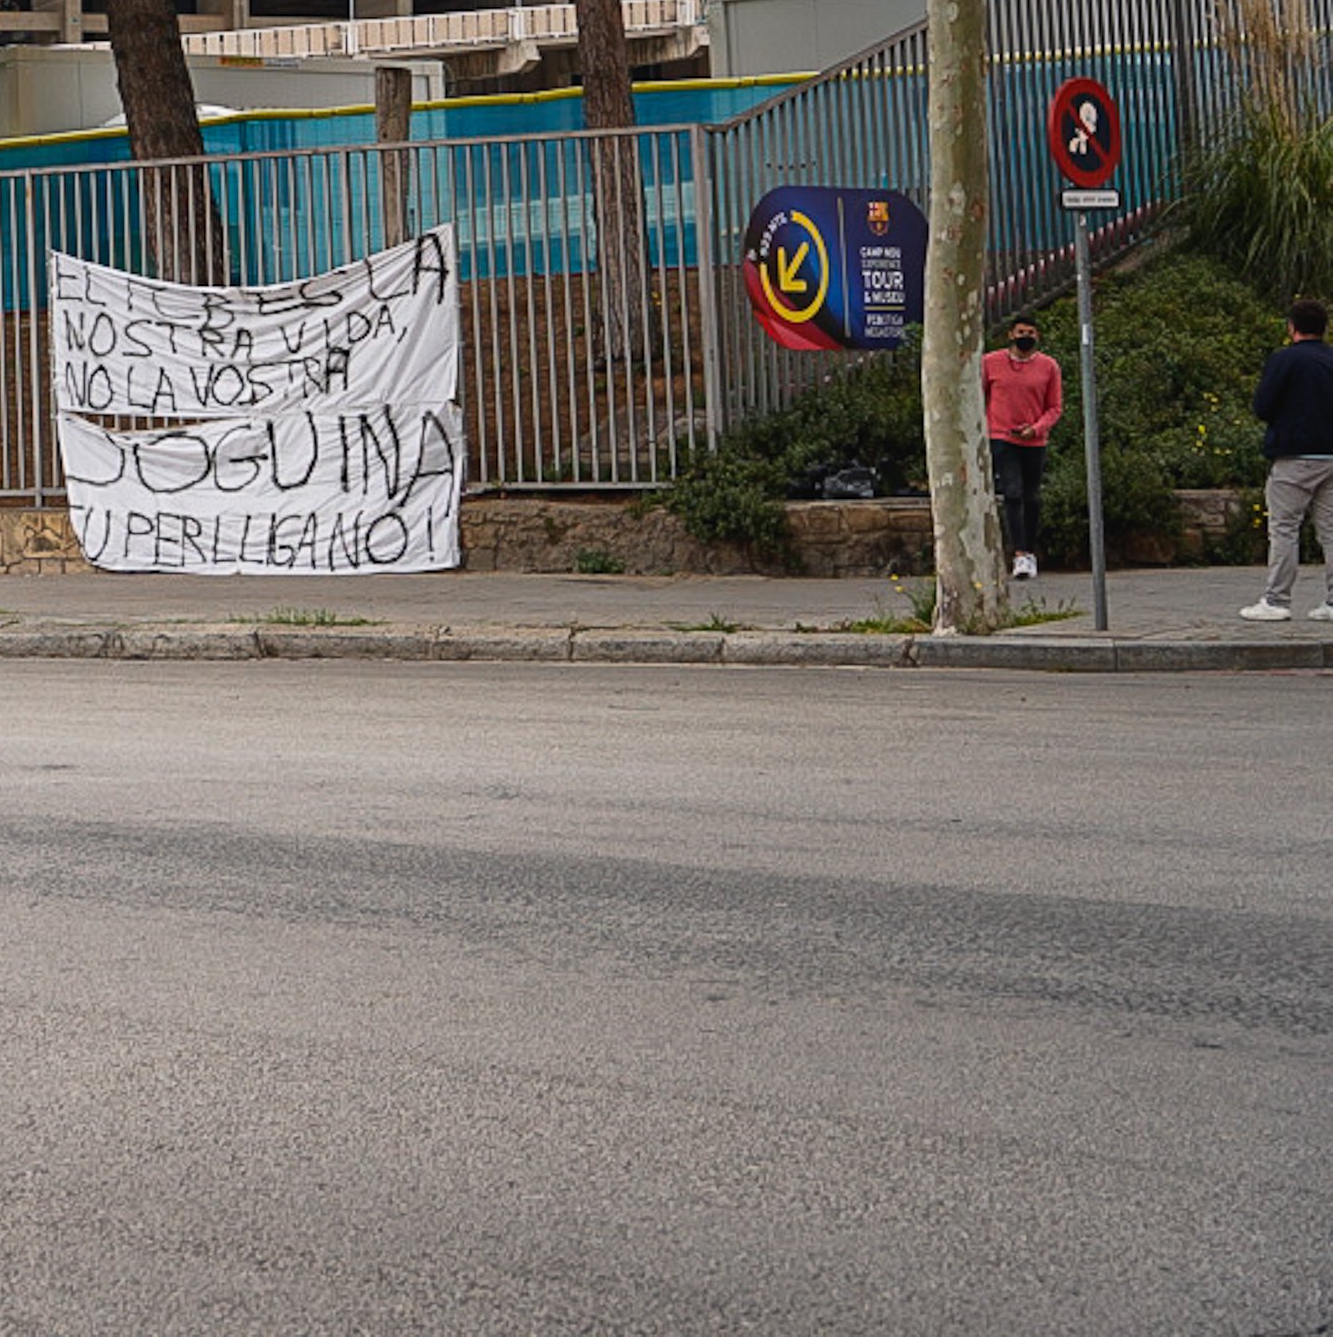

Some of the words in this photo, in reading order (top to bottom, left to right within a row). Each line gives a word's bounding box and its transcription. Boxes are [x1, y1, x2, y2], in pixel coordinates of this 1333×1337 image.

[56, 255, 106, 308] EL
[364, 232, 449, 305] LA
[860, 246, 883, 259] CAMP
[884, 246, 901, 259] NOU
[861, 270, 904, 290] TOUR
[872, 291, 905, 304] MUSEU
[63, 309, 254, 364] NOSTRA
[279, 304, 408, 354] VIDA,
[65, 361, 114, 410] NO
[128, 365, 178, 414] LA
[189, 345, 350, 406] VOSTRA
[66, 404, 455, 518] JOGUINA
